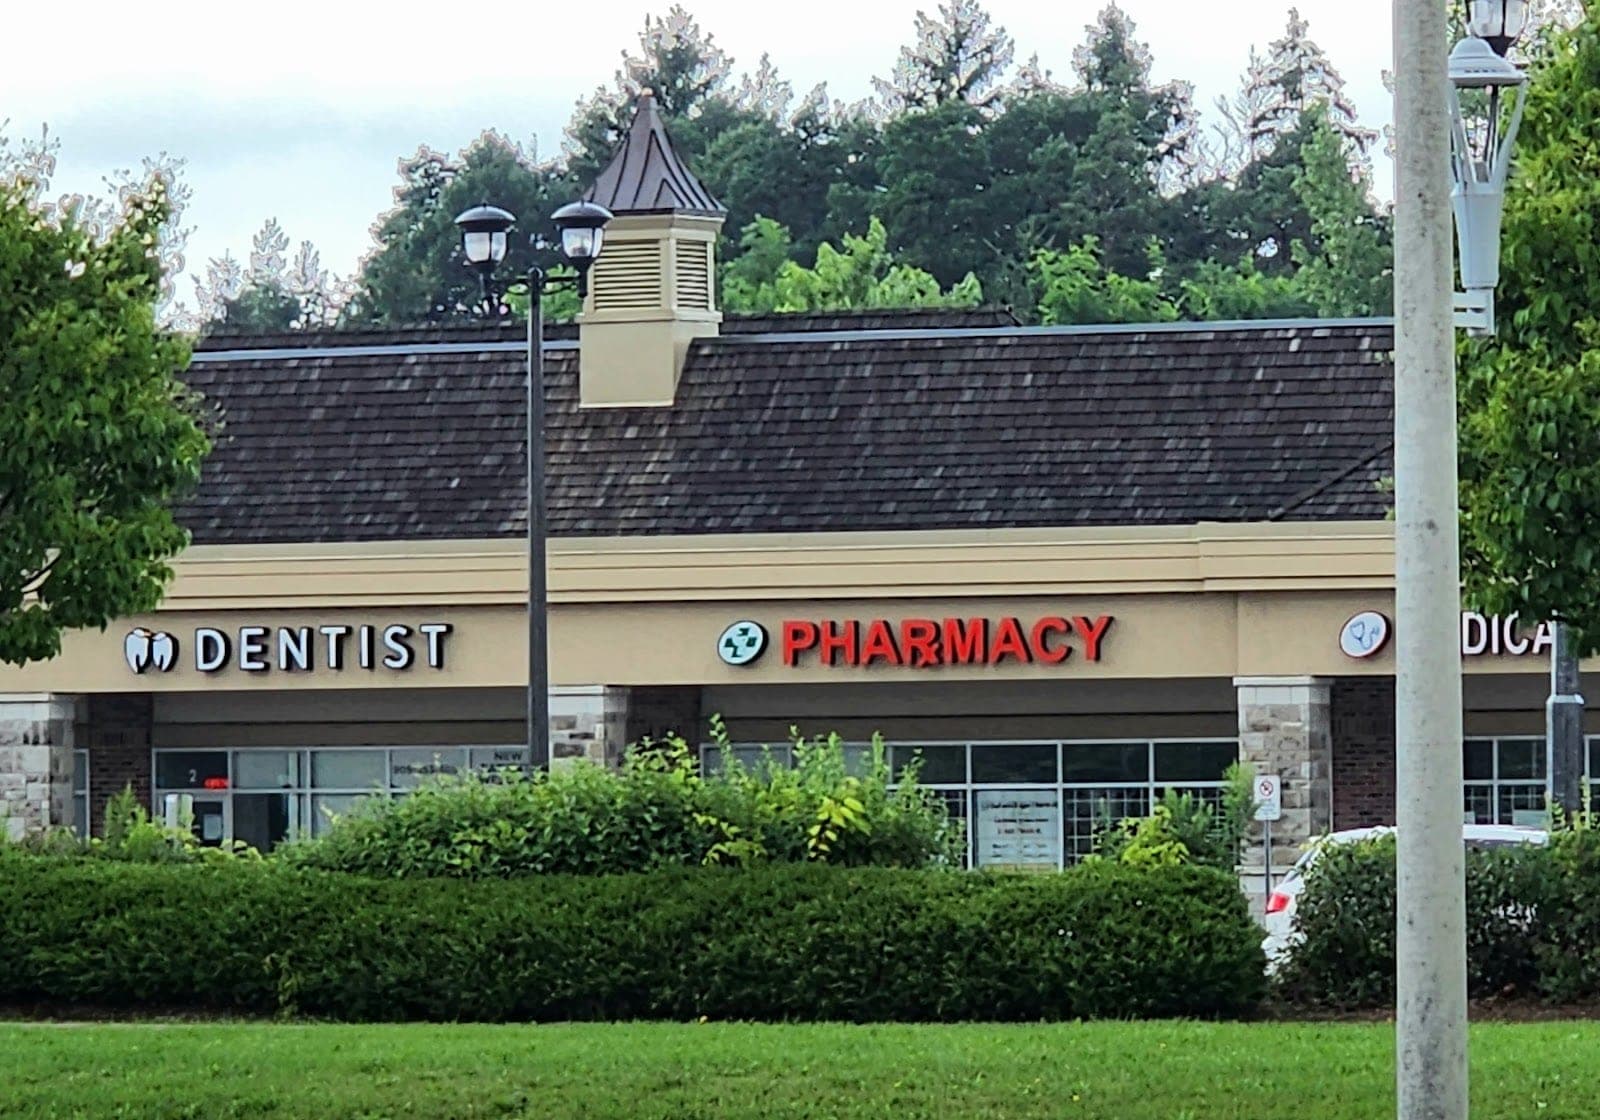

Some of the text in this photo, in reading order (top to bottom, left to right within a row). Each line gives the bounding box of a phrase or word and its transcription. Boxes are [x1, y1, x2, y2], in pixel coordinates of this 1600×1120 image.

[194, 624, 452, 671] DENTIST
[783, 616, 1112, 667] PHARMACY
[1462, 611, 1556, 654] DICA
[188, 769, 197, 782] 2
